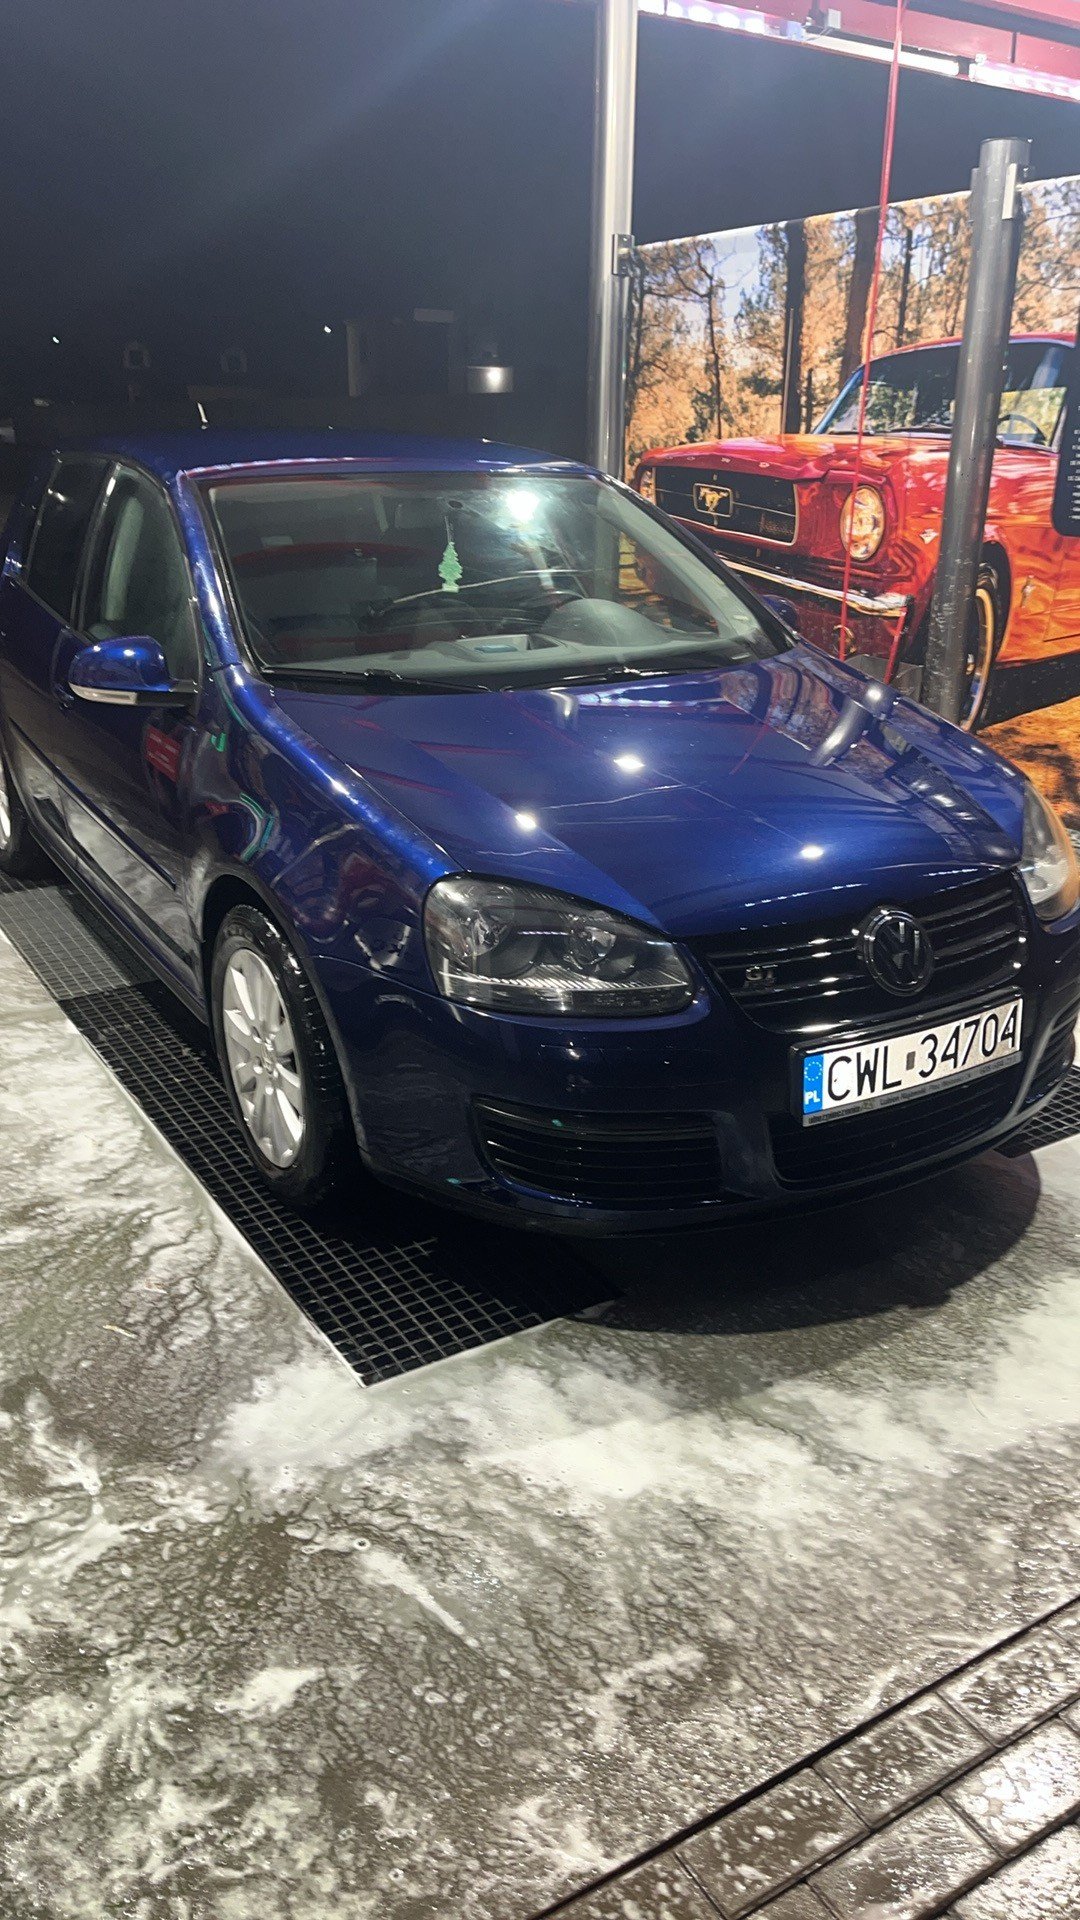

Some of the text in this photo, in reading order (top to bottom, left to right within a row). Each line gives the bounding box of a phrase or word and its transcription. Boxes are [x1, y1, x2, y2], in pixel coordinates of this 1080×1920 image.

[827, 1046, 902, 1101] CWL
[918, 1004, 1018, 1079] 34704
[804, 1091, 820, 1105] PL
